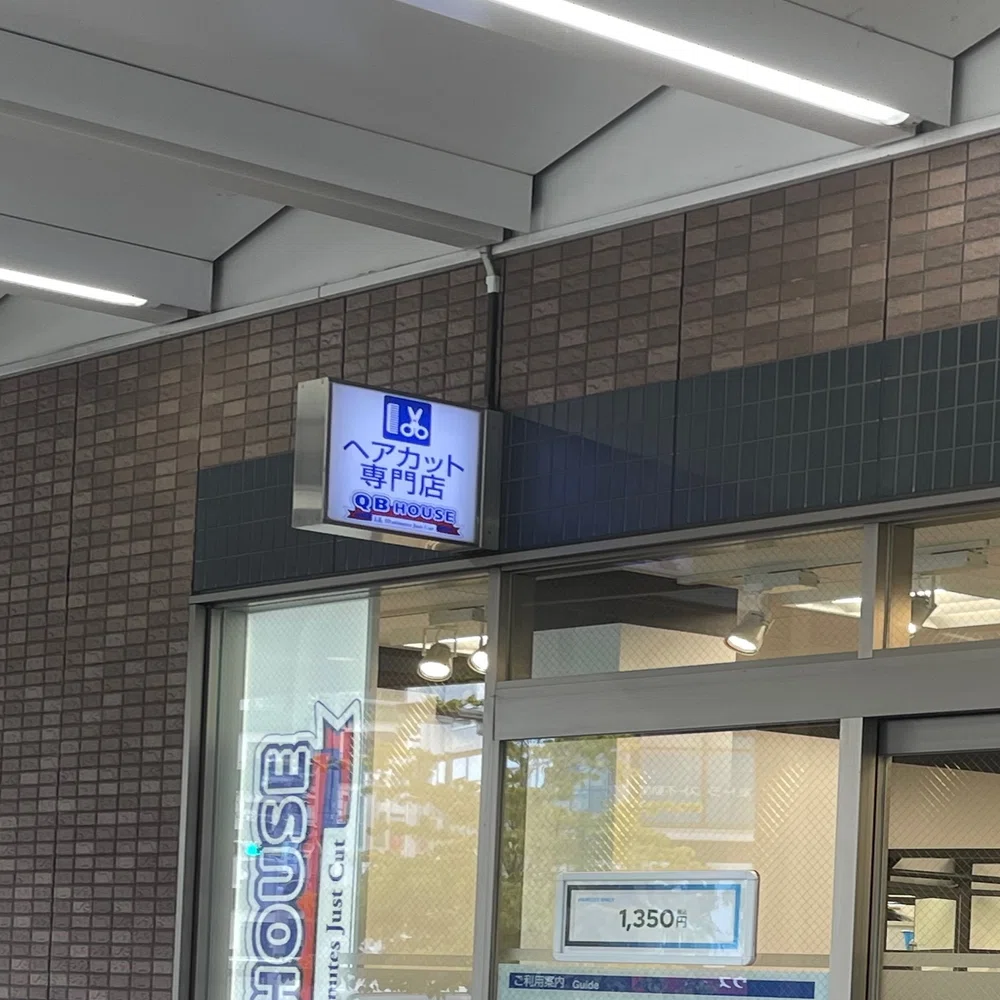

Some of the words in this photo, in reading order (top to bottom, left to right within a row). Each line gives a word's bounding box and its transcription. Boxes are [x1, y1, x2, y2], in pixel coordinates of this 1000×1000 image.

[343, 440, 465, 477] ヘアカット
[360, 463, 446, 500] 専門店
[354, 494, 391, 512] QB
[395, 503, 456, 523] HOUSE
[328, 839, 346, 882] Cut
[325, 889, 344, 934] Just
[513, 975, 565, 989] ご利用案内
[572, 980, 600, 991] Guide
